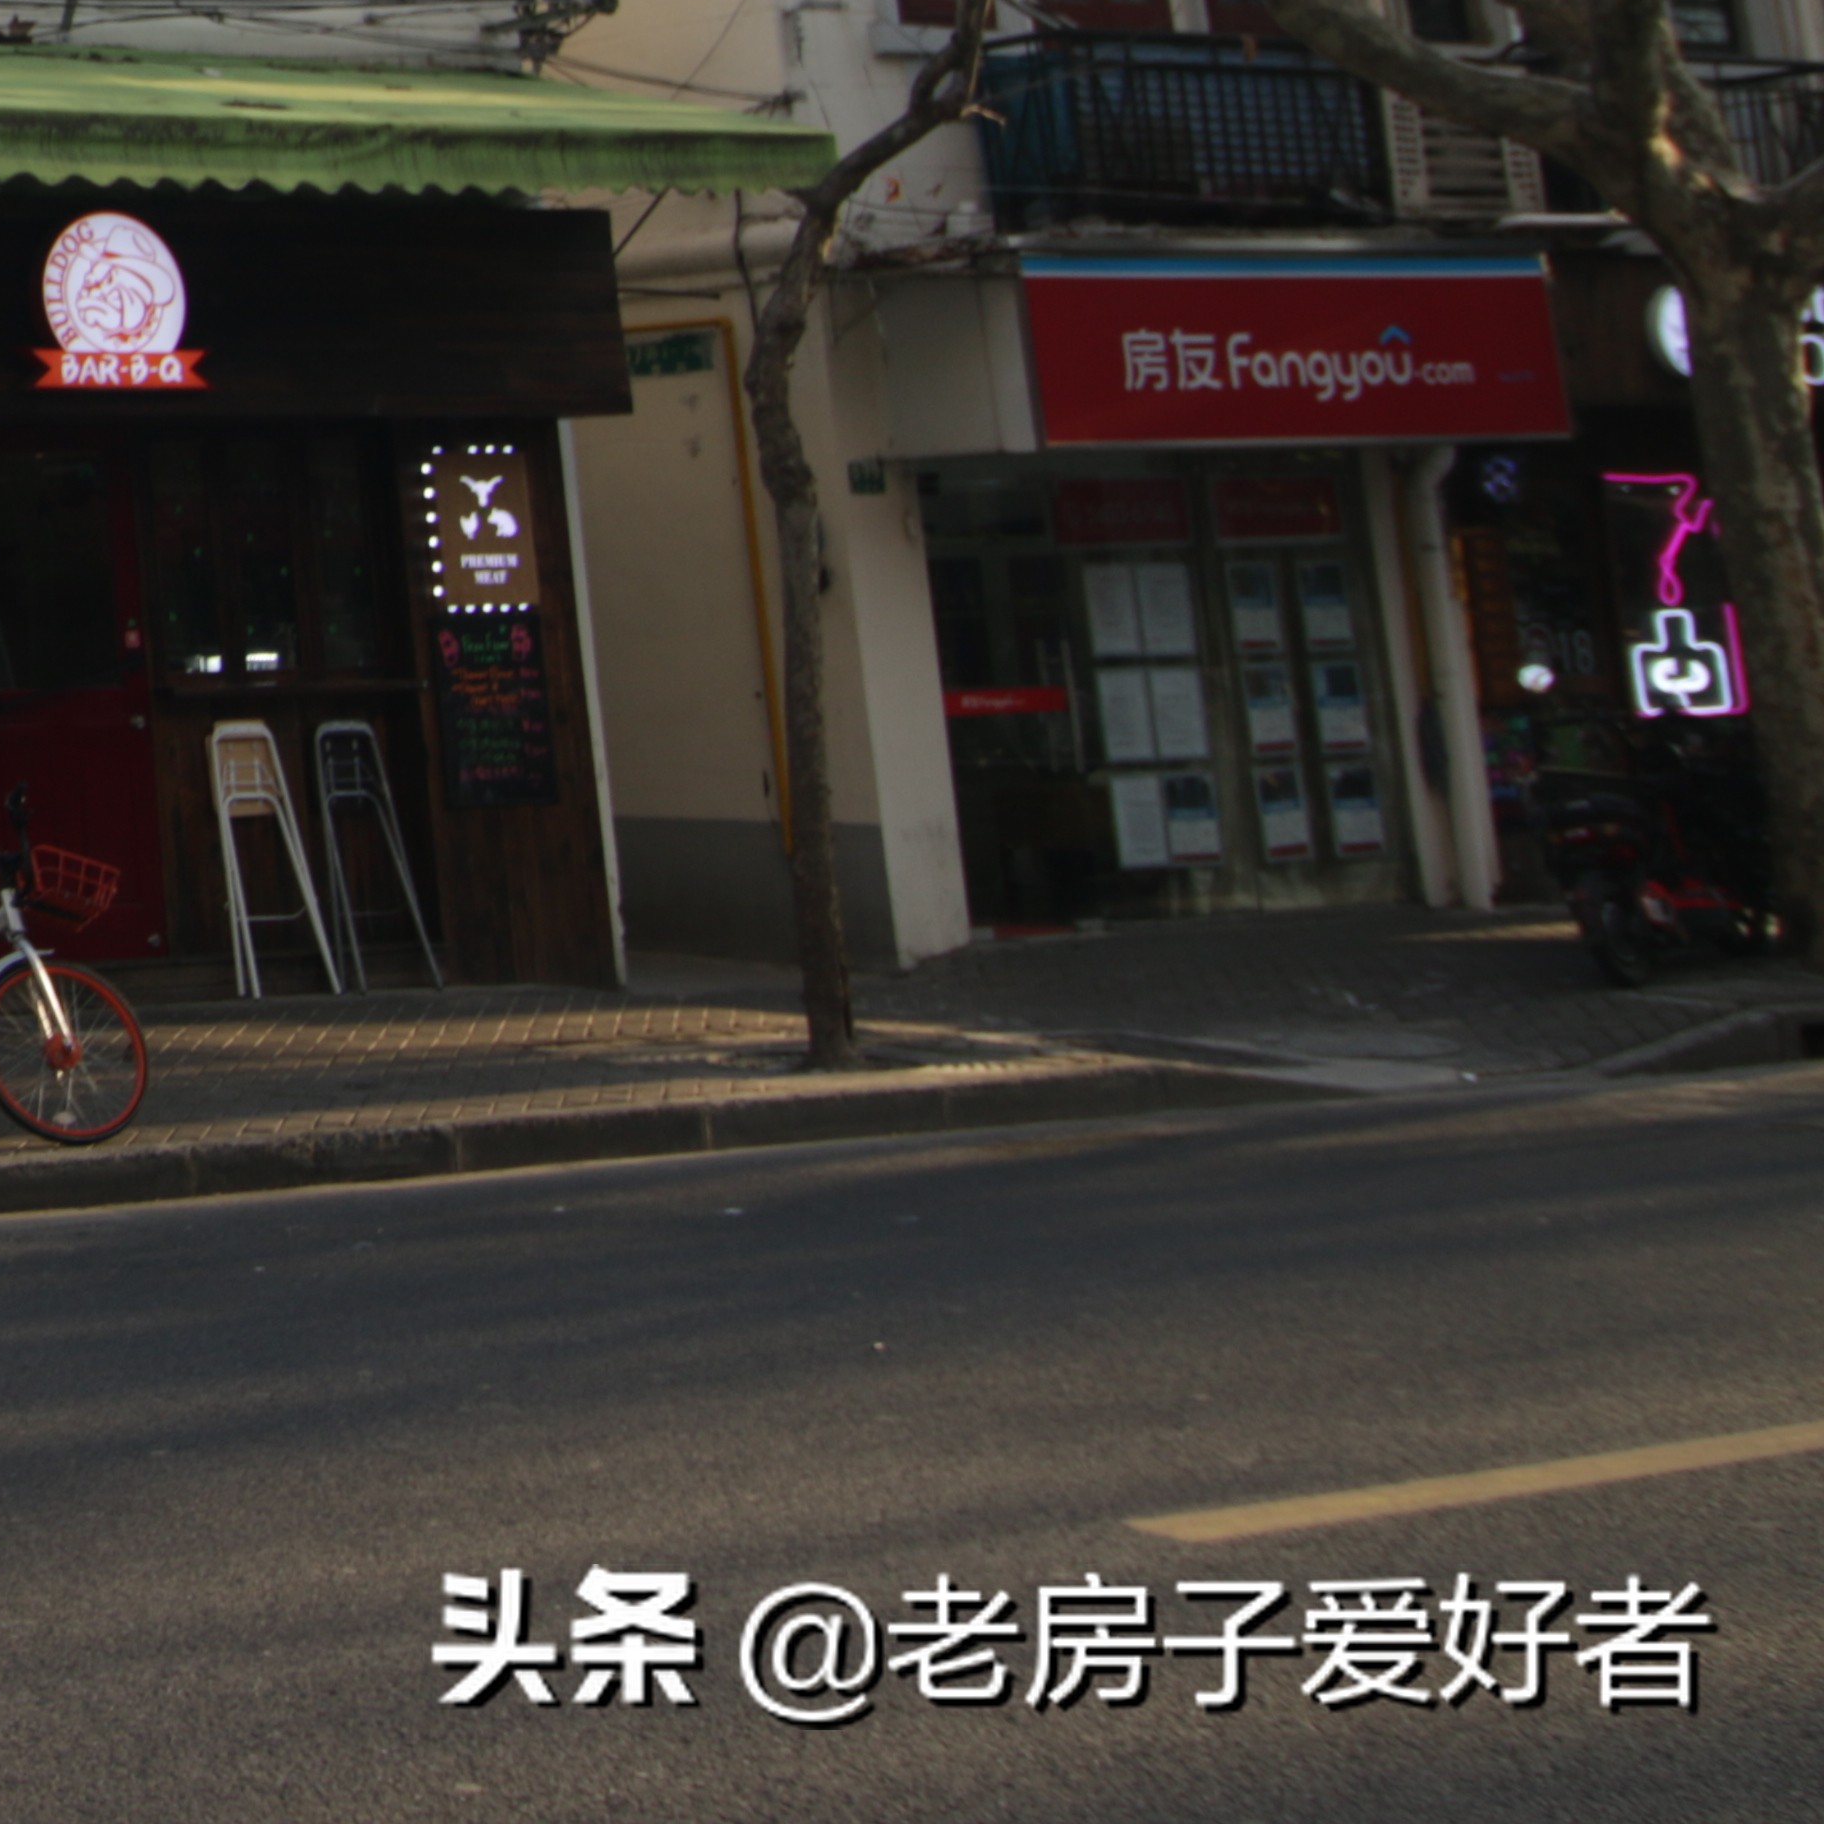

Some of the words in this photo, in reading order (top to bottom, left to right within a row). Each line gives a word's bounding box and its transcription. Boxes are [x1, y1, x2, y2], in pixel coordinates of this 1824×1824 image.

[44, 221, 94, 348] BULLDOG
[60, 353, 184, 385] BAR-B-Q
[1121, 328, 1223, 391] 房友
[459, 553, 520, 569] PREMIUM
[474, 569, 508, 586] MEAT
